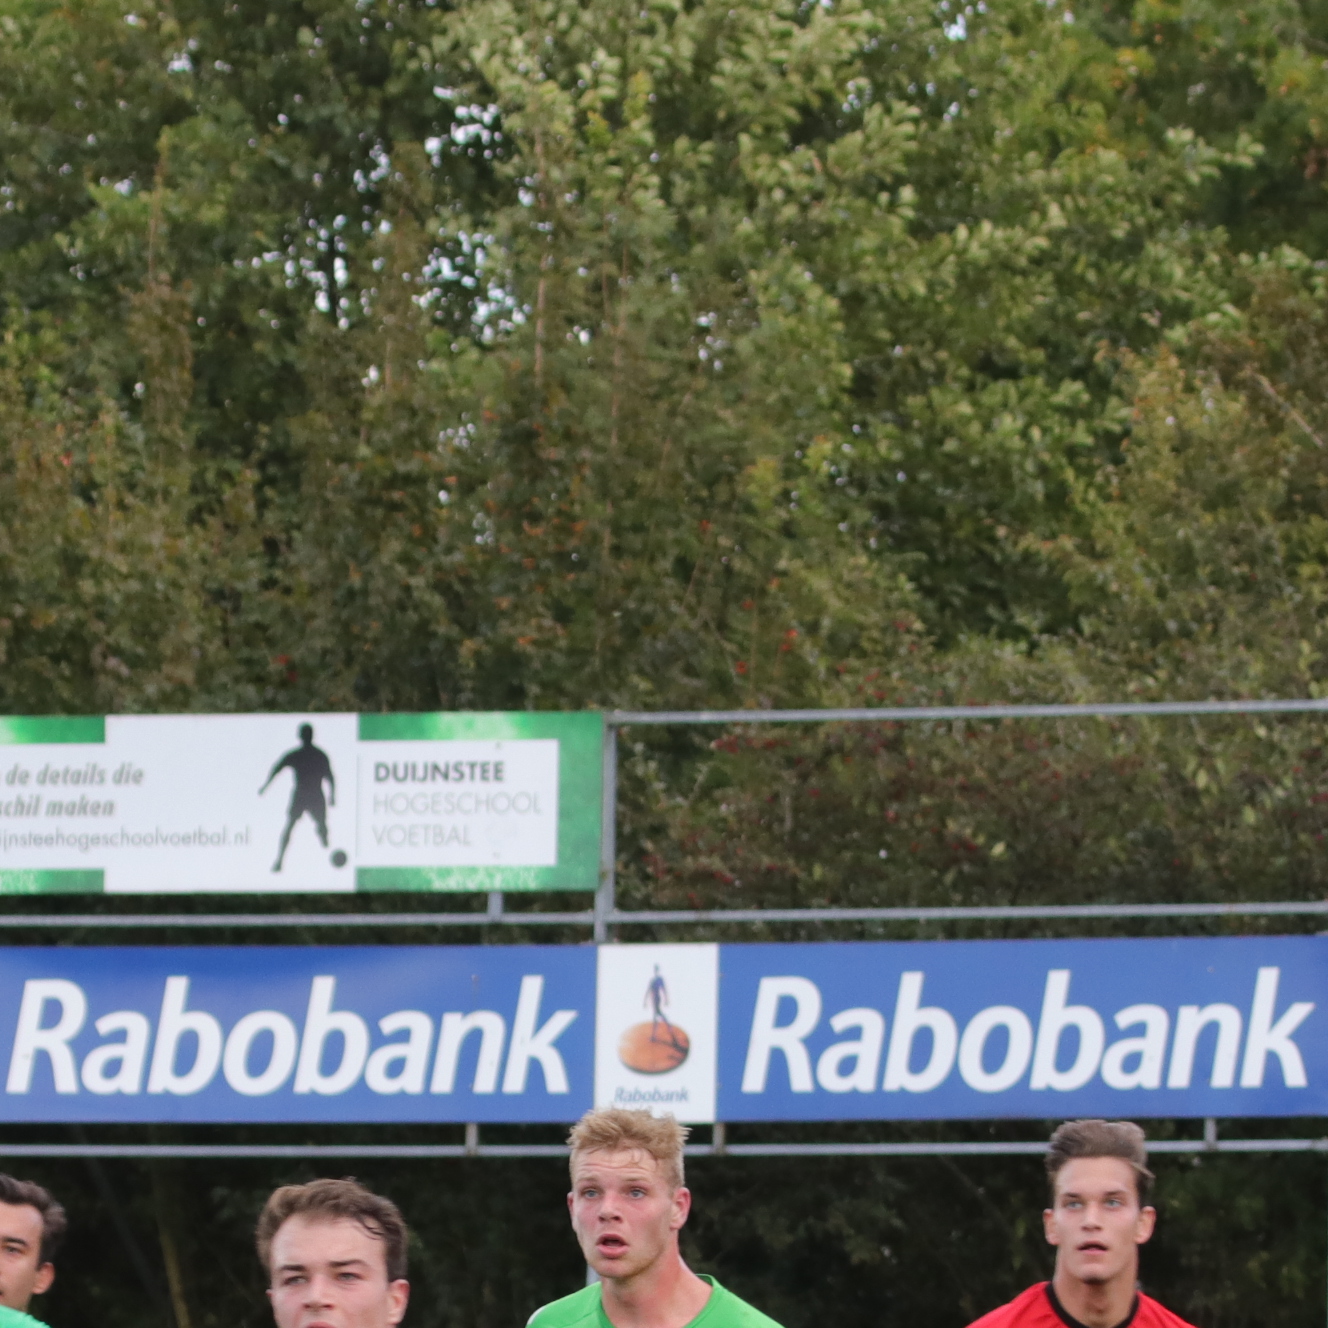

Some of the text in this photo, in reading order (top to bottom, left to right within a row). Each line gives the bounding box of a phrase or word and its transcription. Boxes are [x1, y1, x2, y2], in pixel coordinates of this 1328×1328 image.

[5, 763, 29, 786] de
[36, 762, 106, 786] details
[112, 762, 143, 786] die
[374, 761, 505, 783] DUIJNSTEE
[45, 795, 115, 817] maken
[373, 791, 541, 815] HOGESCHOOL
[372, 824, 471, 846] VOETBAL
[6, 975, 576, 1096] Rabobank
[742, 966, 1315, 1093] Rabobank
[614, 1085, 689, 1103] Rabobank
